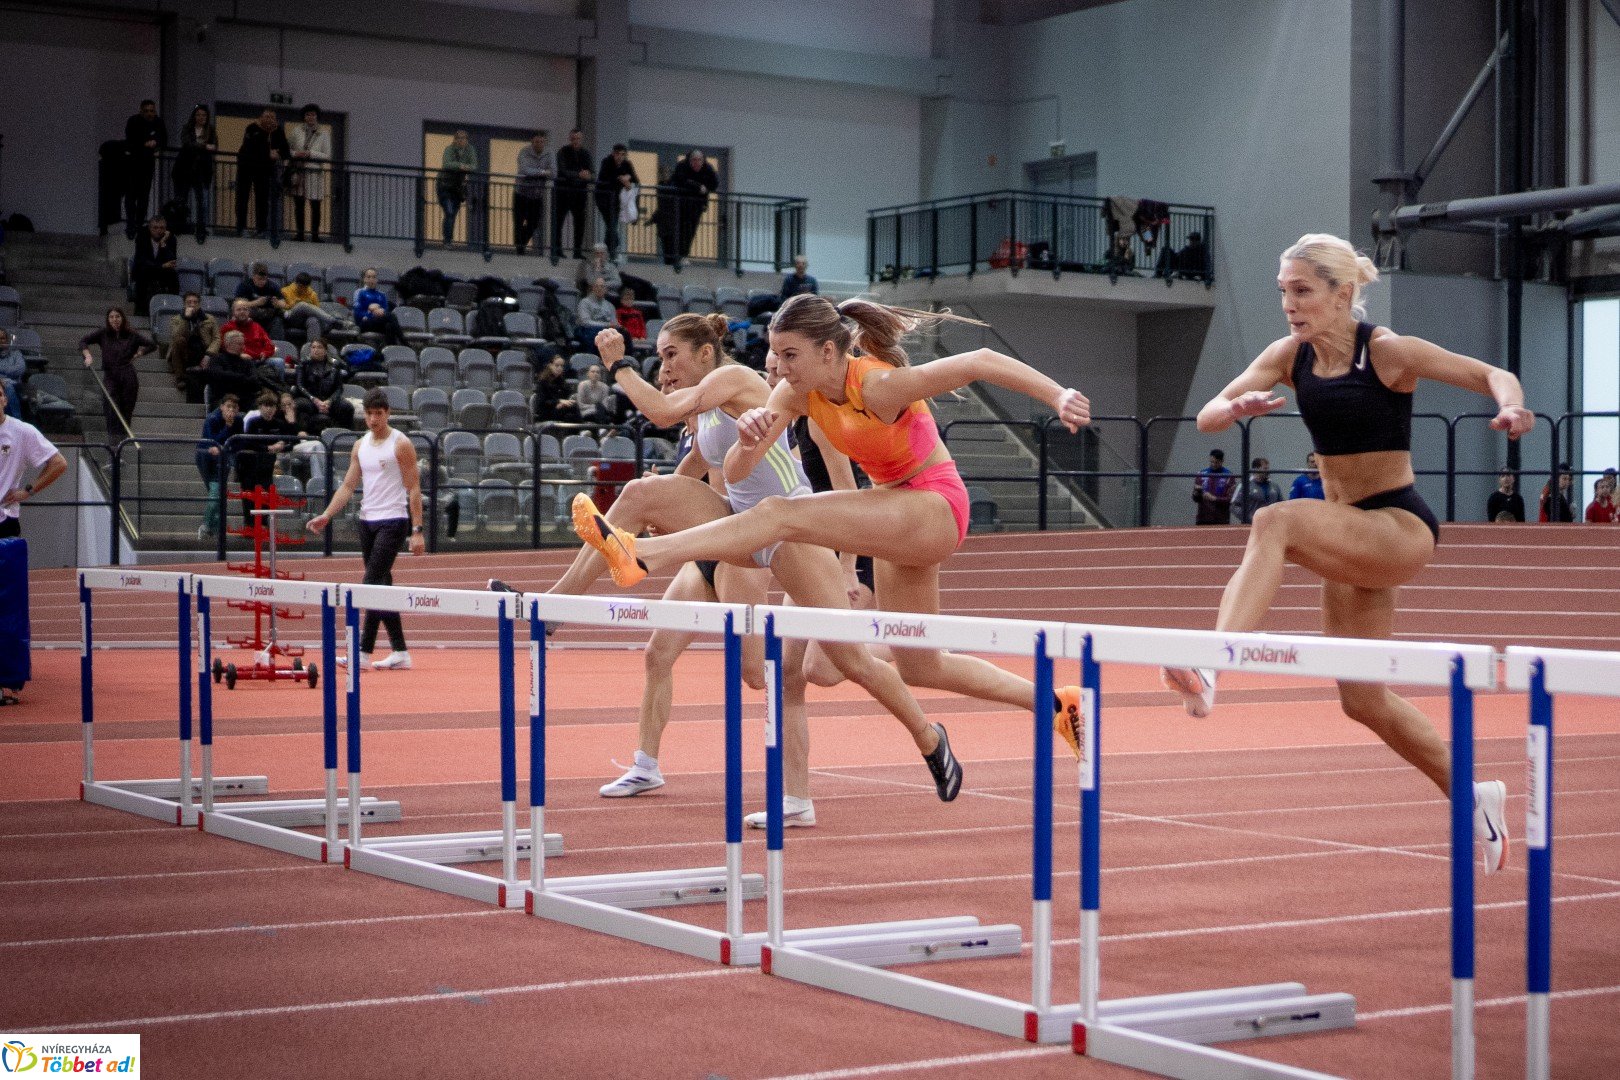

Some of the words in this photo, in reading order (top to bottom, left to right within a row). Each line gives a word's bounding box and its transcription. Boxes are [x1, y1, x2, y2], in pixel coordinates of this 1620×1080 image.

[125, 575, 142, 587] polanik
[254, 585, 275, 596] polanik
[414, 594, 440, 608] polanik
[617, 605, 649, 622] polanik
[883, 620, 928, 639] polanik
[1239, 643, 1299, 666] polanik
